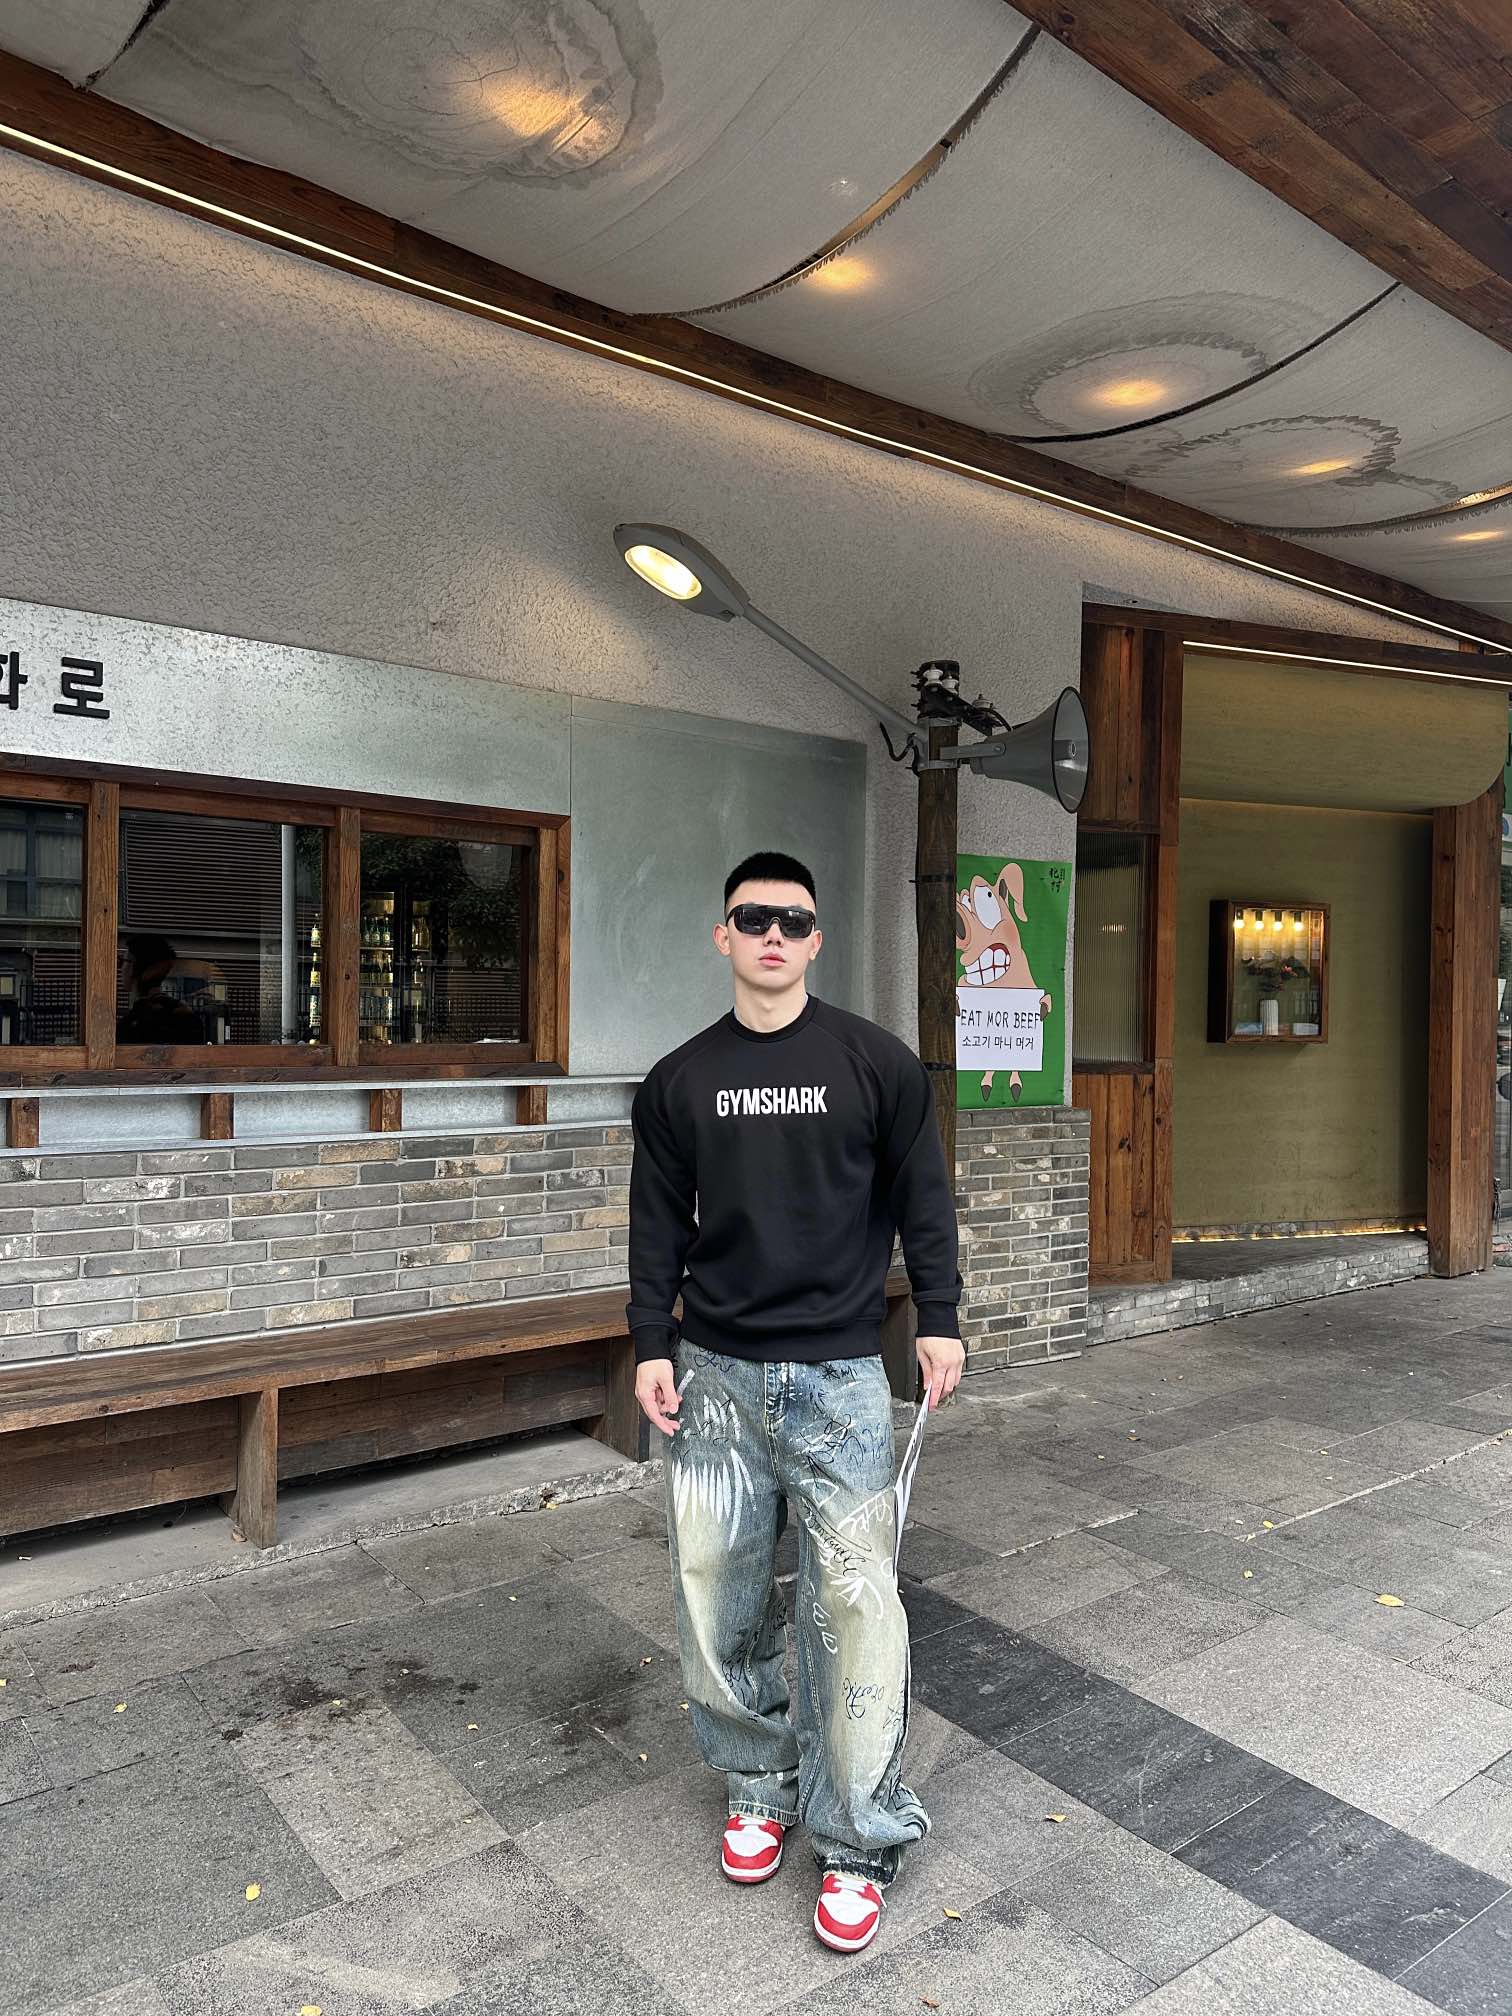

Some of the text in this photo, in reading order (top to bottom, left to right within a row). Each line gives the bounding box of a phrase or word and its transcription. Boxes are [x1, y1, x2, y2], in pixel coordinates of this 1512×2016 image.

[961, 1009, 1040, 1029] EAT MOR BEEF
[962, 1036, 1034, 1050] 소고기 마니 머거
[716, 1086, 828, 1117] GYMSHARK
